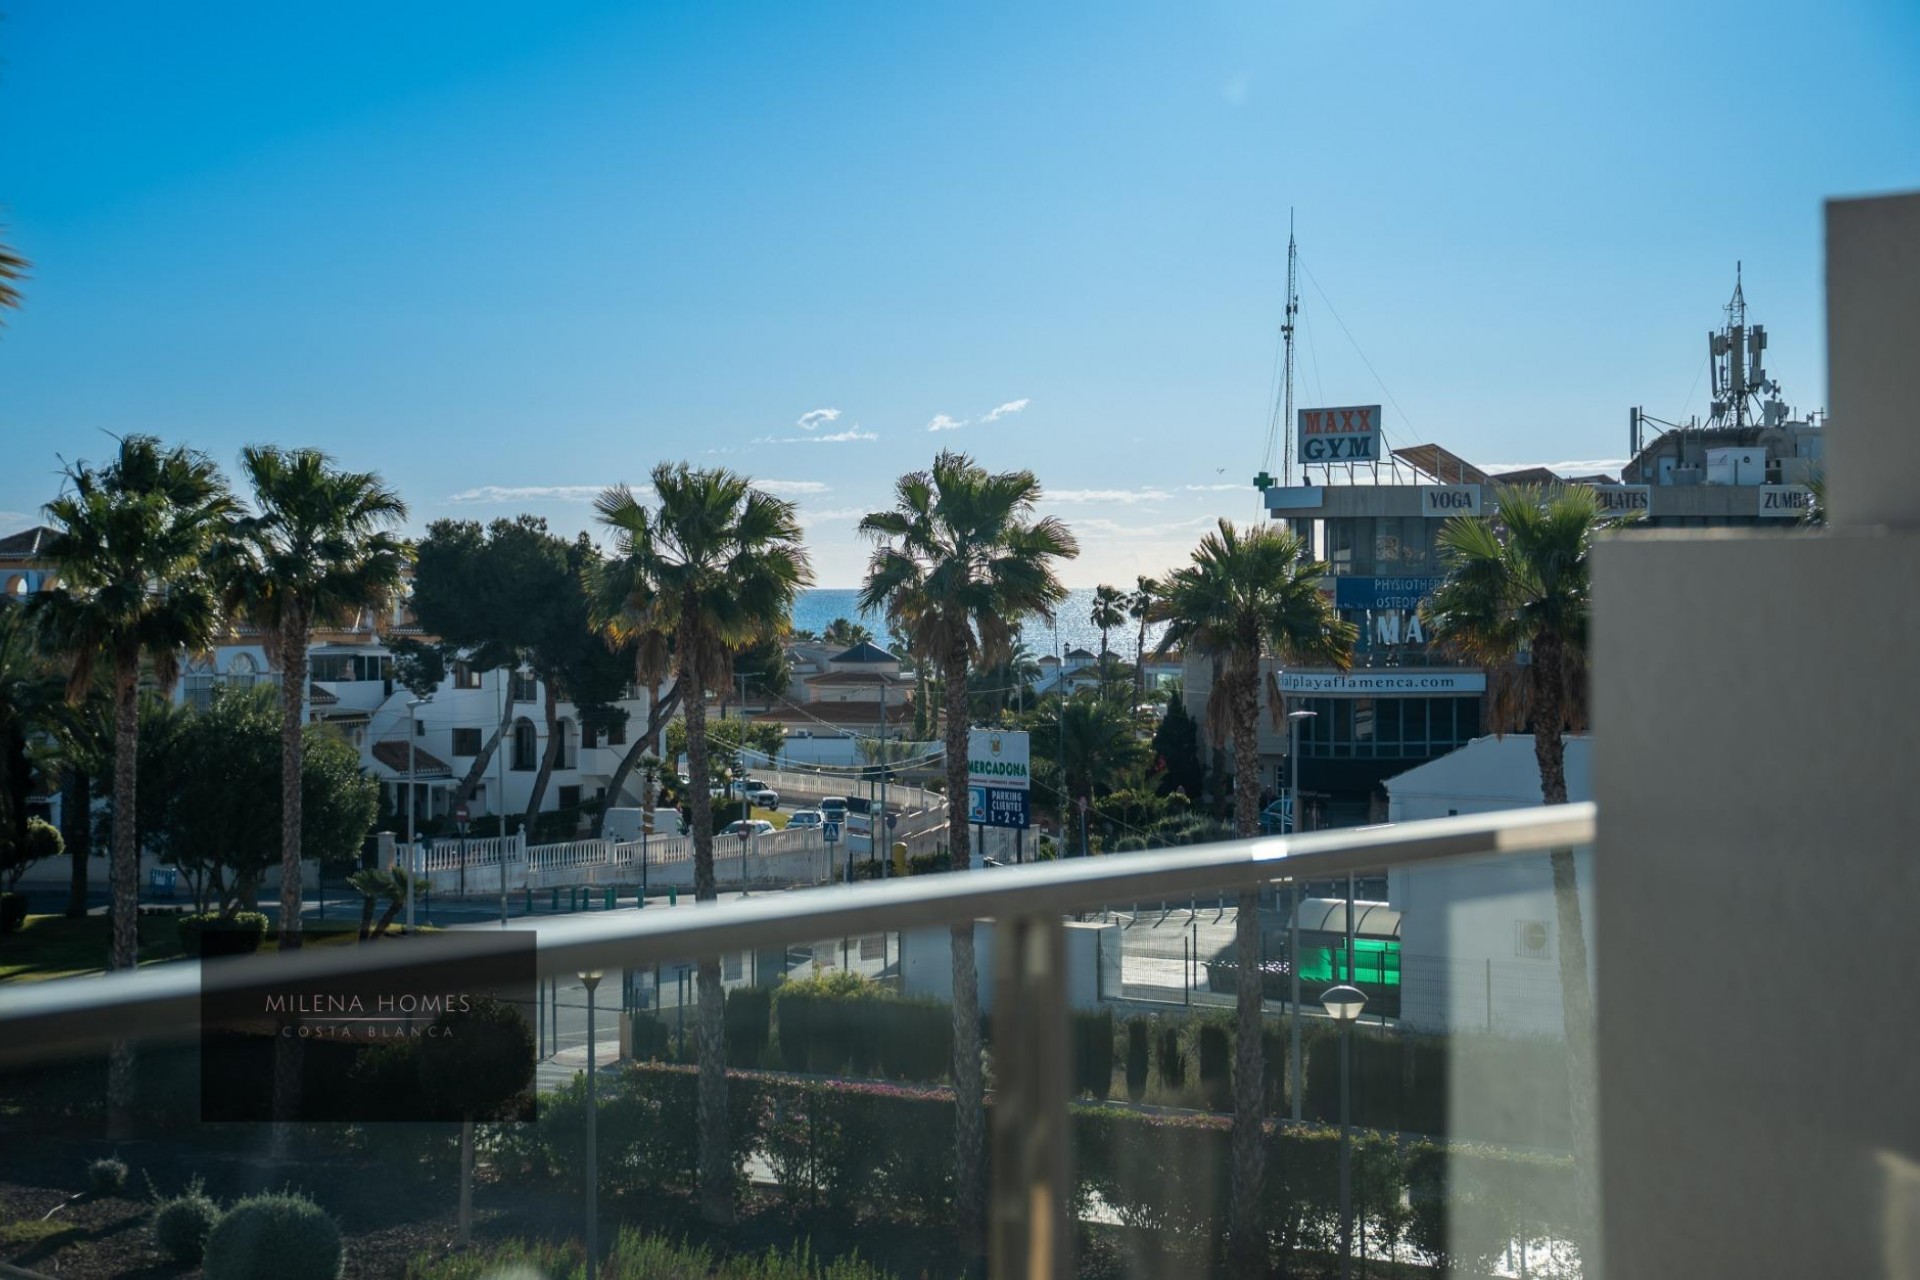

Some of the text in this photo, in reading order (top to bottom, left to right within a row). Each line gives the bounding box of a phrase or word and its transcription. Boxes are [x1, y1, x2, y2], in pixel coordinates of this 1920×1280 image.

[1304, 409, 1372, 435] MAXX
[1304, 436, 1372, 459] GYM
[1430, 491, 1473, 509] YOGA
[1374, 579, 1442, 591] PHYSIOTHER
[969, 761, 1027, 776] MERCADONA
[992, 790, 1022, 801] PARKING
[992, 801, 1022, 811] CLIENTES
